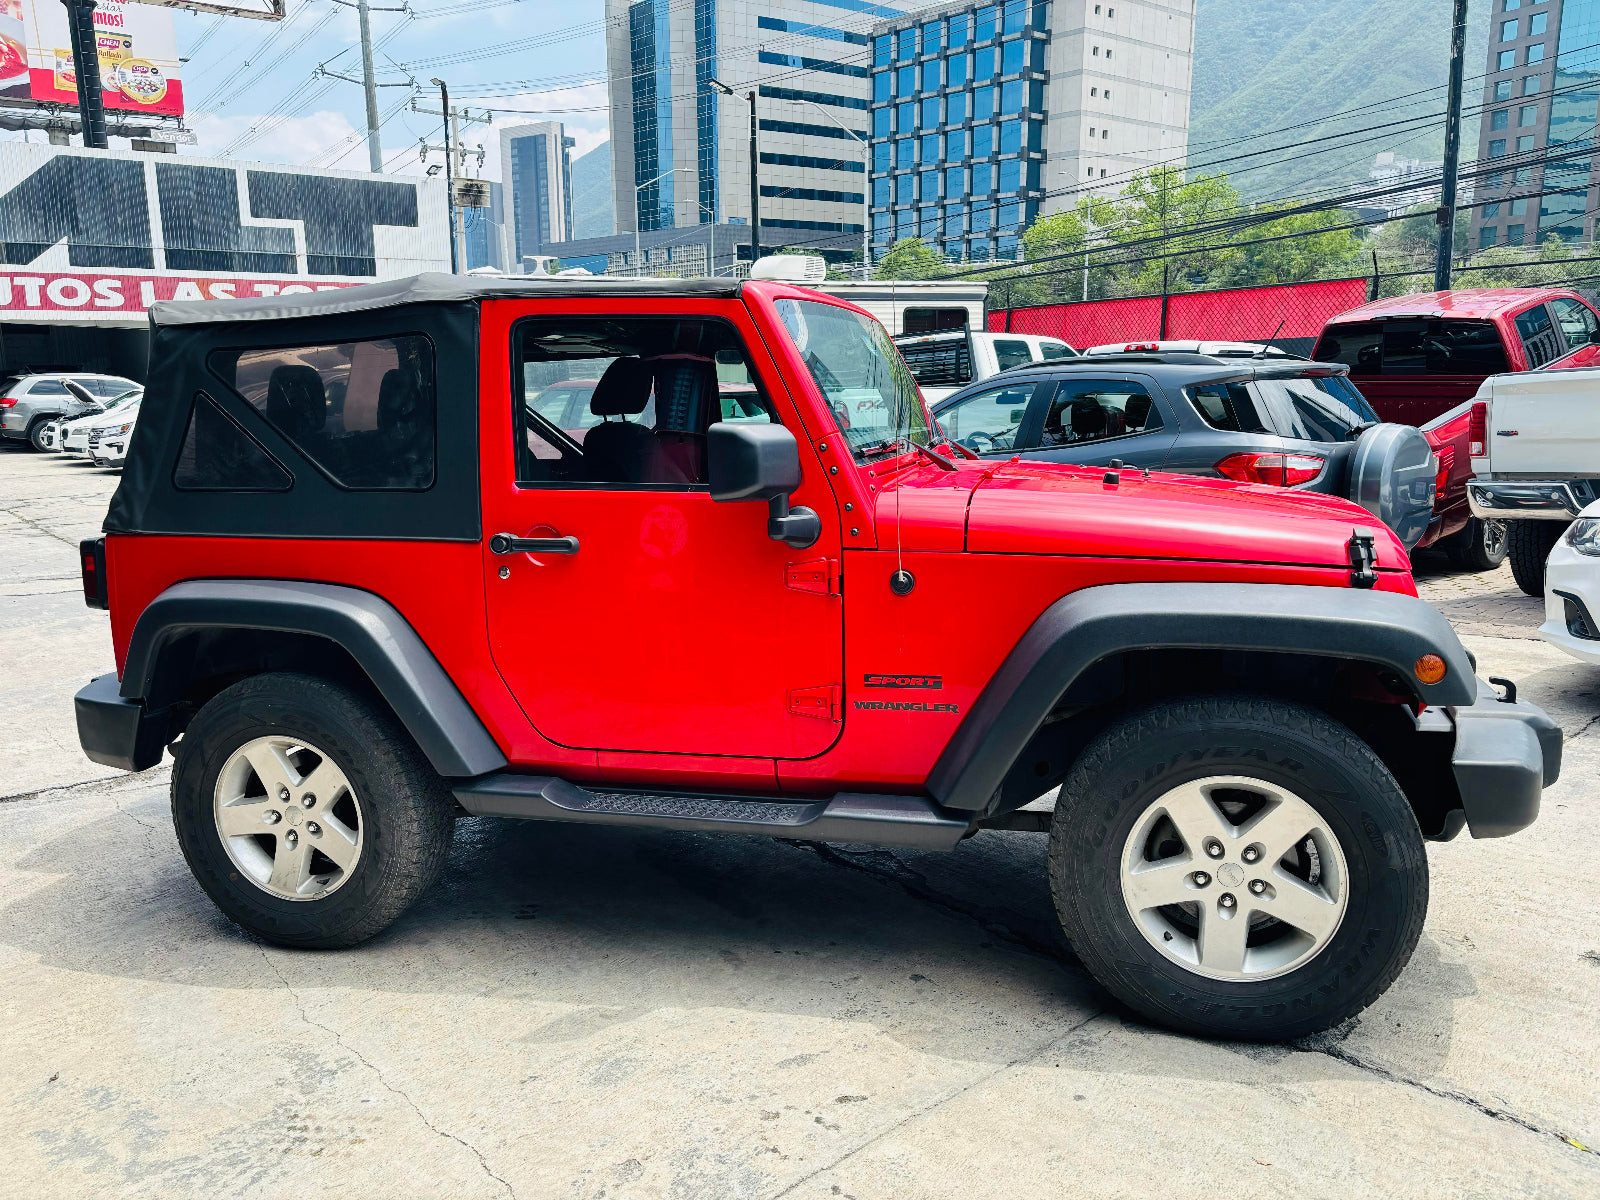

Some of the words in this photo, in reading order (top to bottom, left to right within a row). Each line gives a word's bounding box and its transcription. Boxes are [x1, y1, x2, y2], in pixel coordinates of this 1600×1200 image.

[157, 132, 192, 142] Vendor
[864, 674, 942, 689] SPORT
[854, 701, 959, 713] WRANGLER
